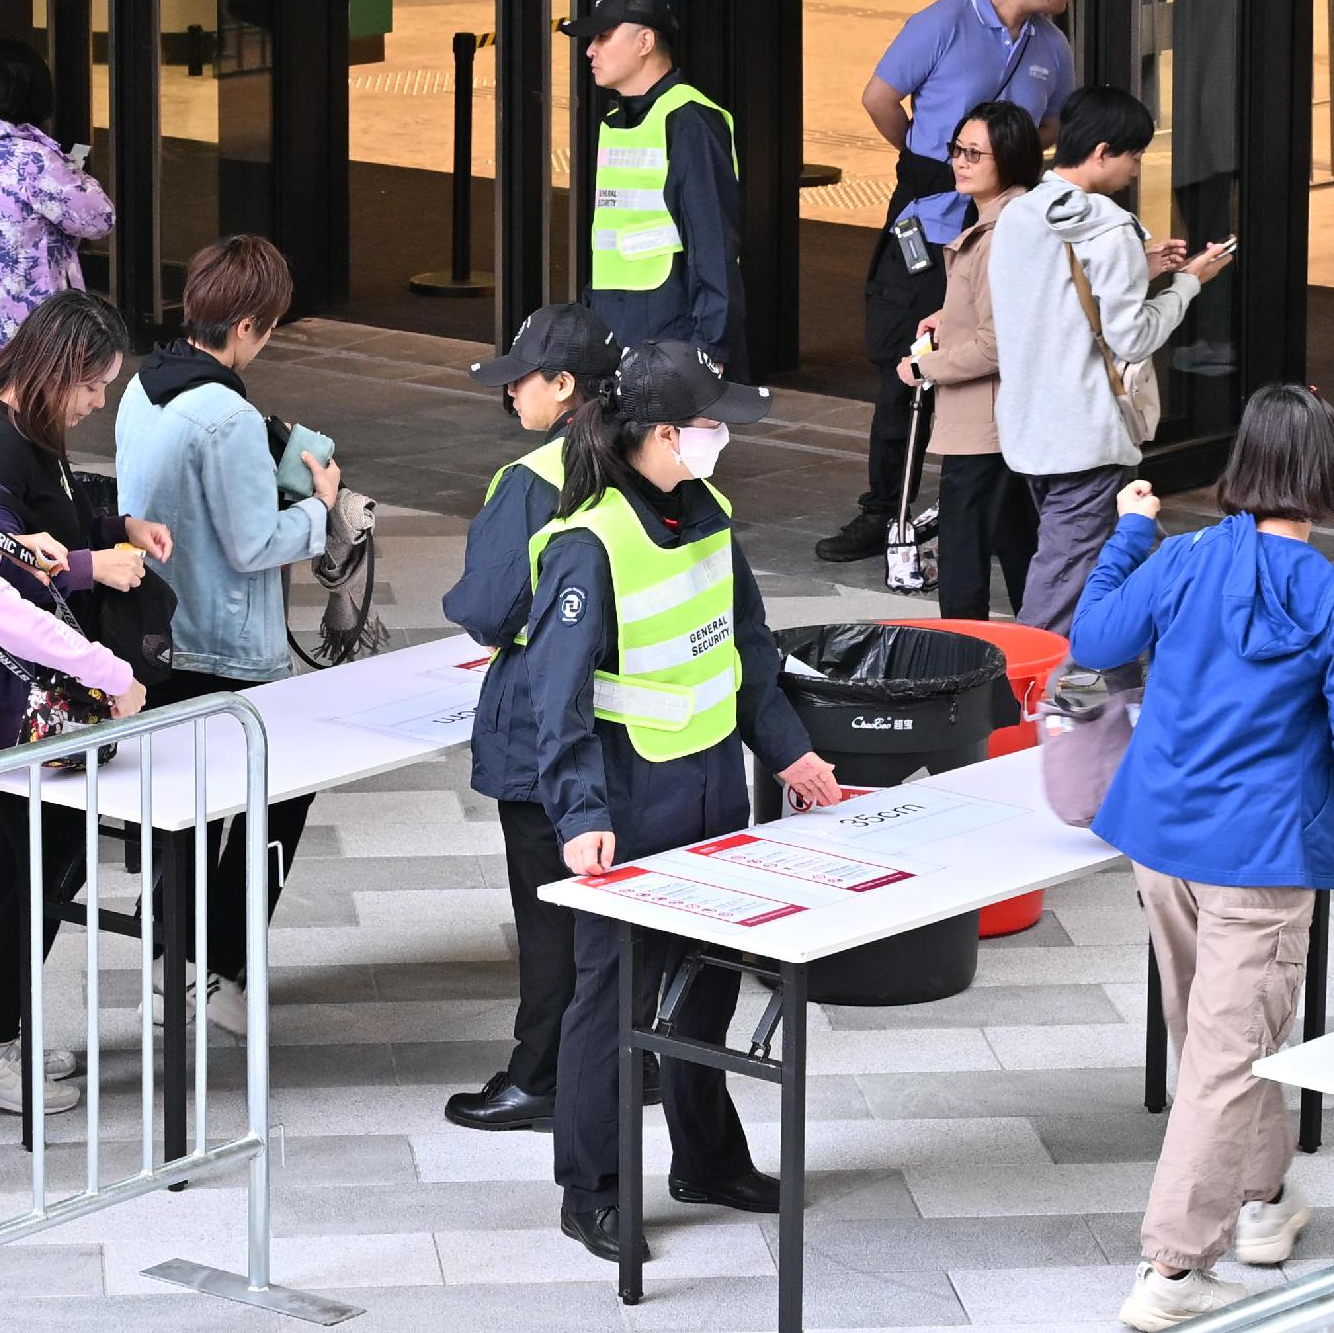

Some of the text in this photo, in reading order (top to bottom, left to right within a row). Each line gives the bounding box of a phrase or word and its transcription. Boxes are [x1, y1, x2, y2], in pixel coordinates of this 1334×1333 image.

[690, 615, 727, 643] GENERAL
[691, 626, 730, 656] SECURITY
[839, 803, 926, 828] 35cm
